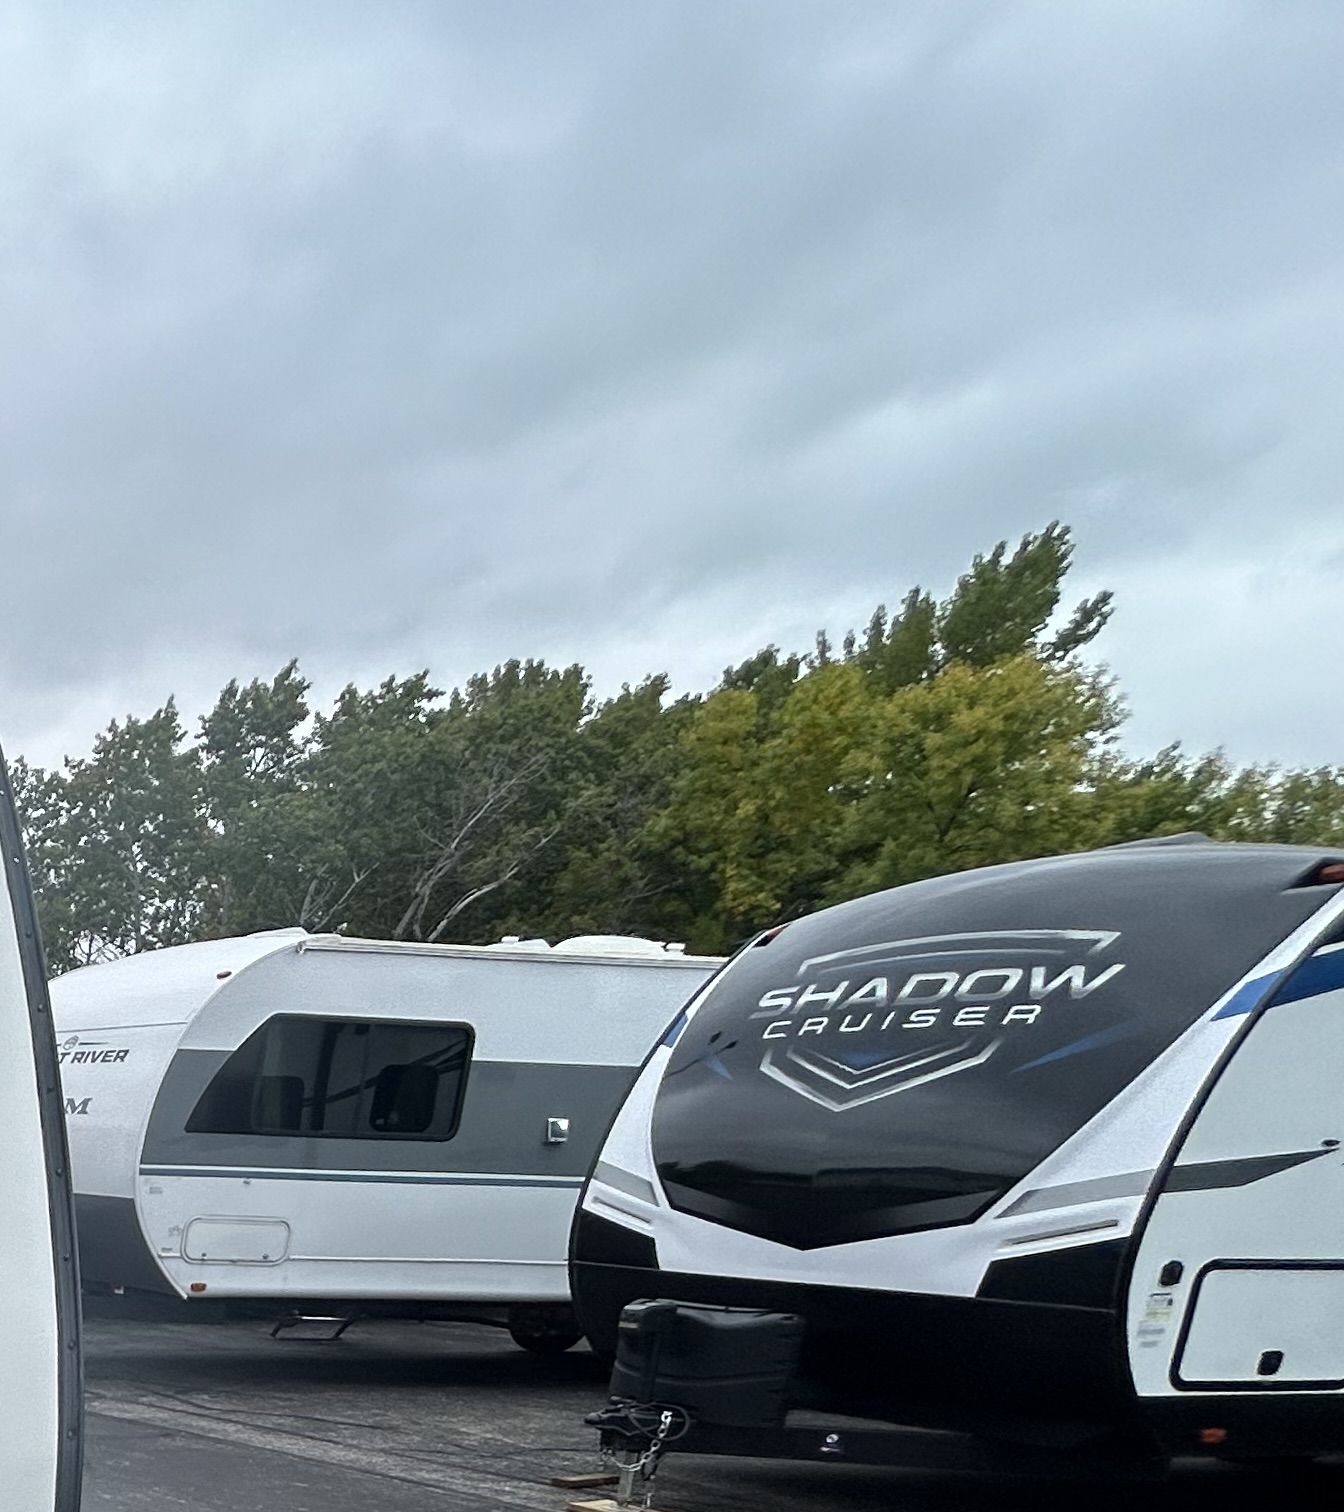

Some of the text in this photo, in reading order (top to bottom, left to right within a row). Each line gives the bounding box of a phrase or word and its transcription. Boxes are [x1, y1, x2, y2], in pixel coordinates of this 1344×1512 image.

[748, 963, 1126, 1020] SHADOW
[762, 1003, 1043, 1040] CRUISER
[70, 1048, 130, 1064] RIVER
